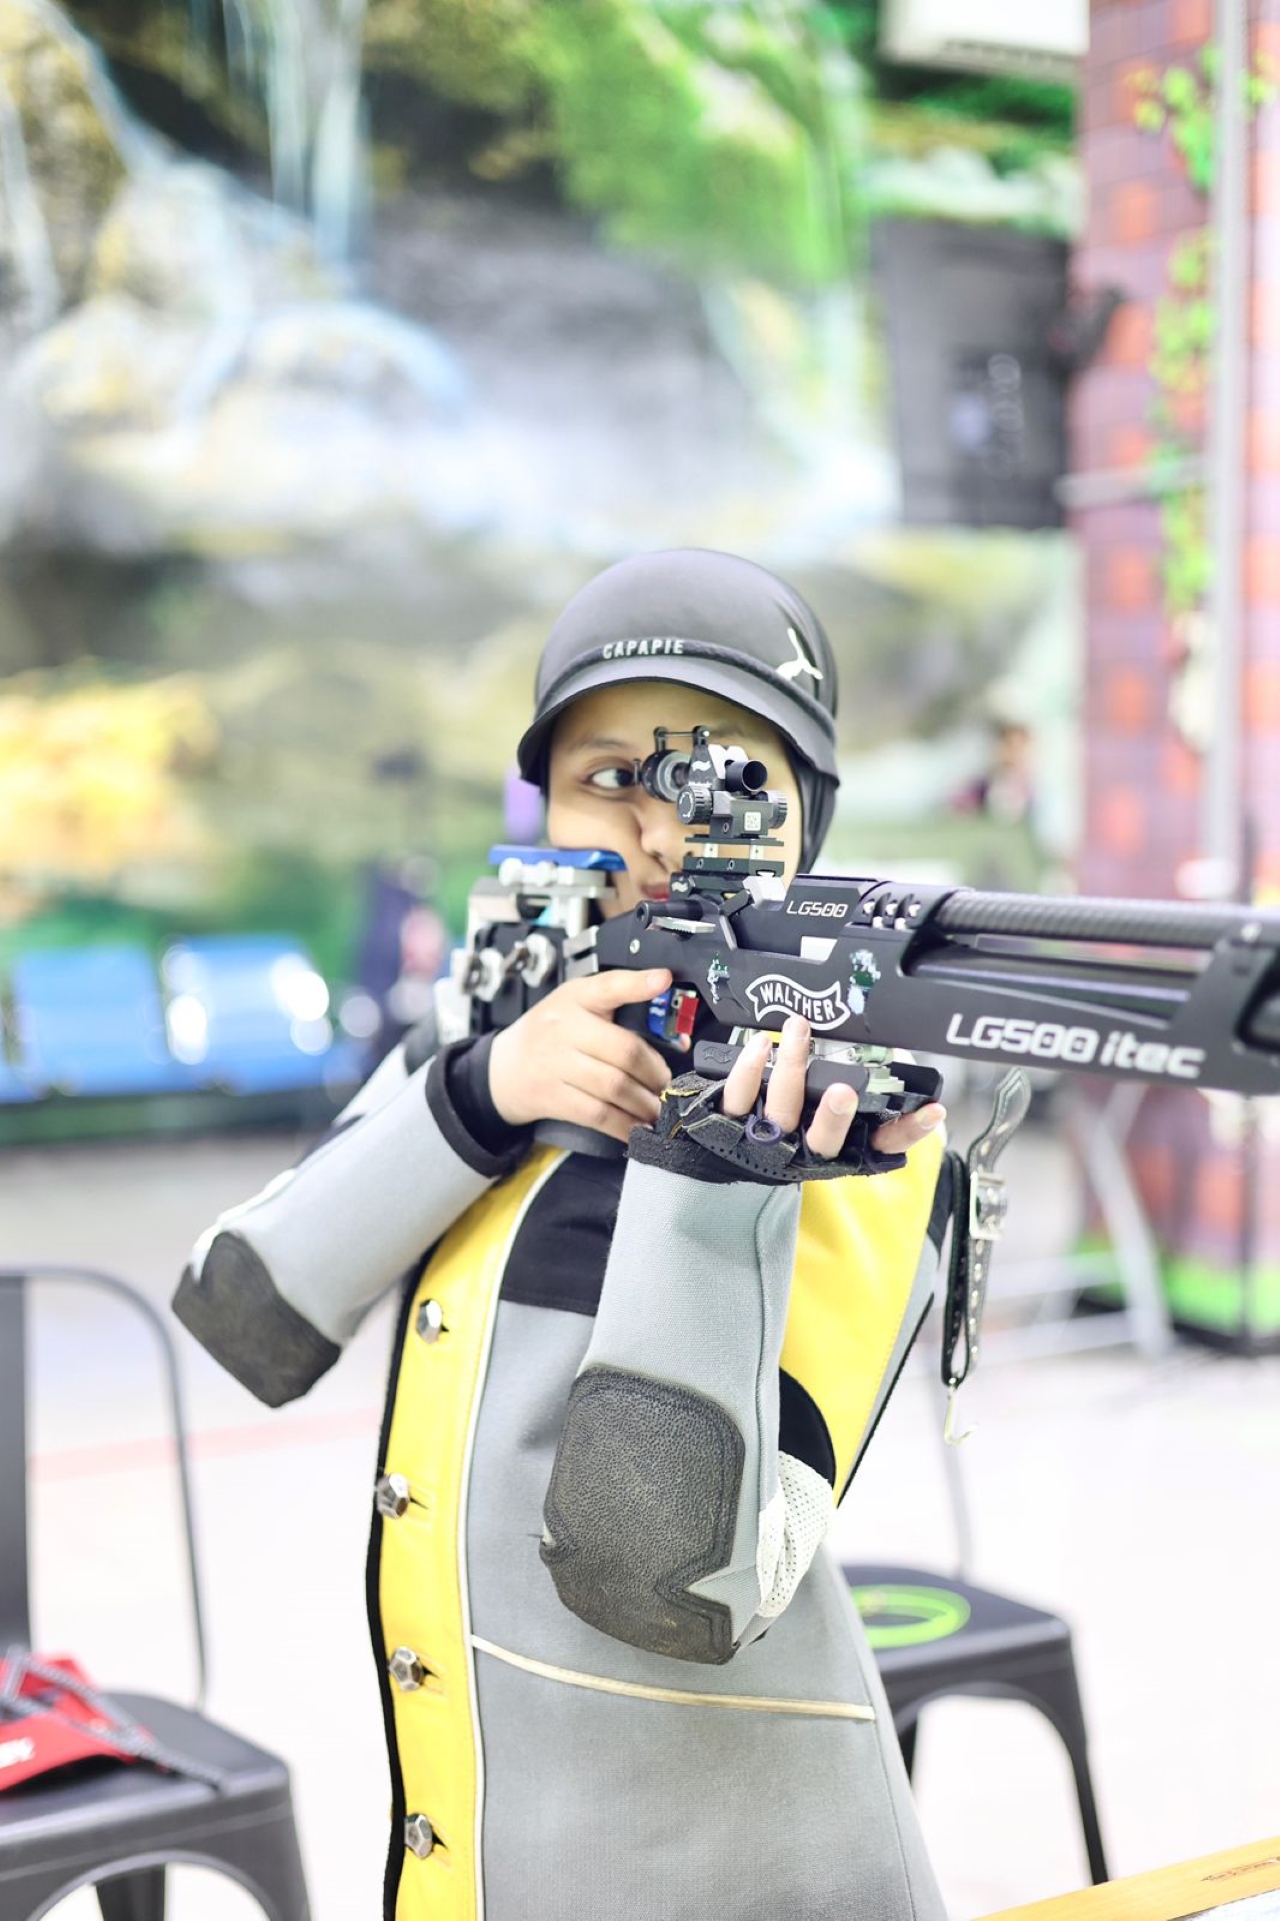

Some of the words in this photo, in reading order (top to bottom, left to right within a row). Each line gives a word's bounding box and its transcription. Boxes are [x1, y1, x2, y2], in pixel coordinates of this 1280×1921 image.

[603, 638, 684, 660] CAPAPIE
[786, 900, 849, 918] LG500
[760, 982, 836, 1021] WALTHER
[946, 1013, 1100, 1063] LG500
[1100, 1030, 1206, 1079] itec
